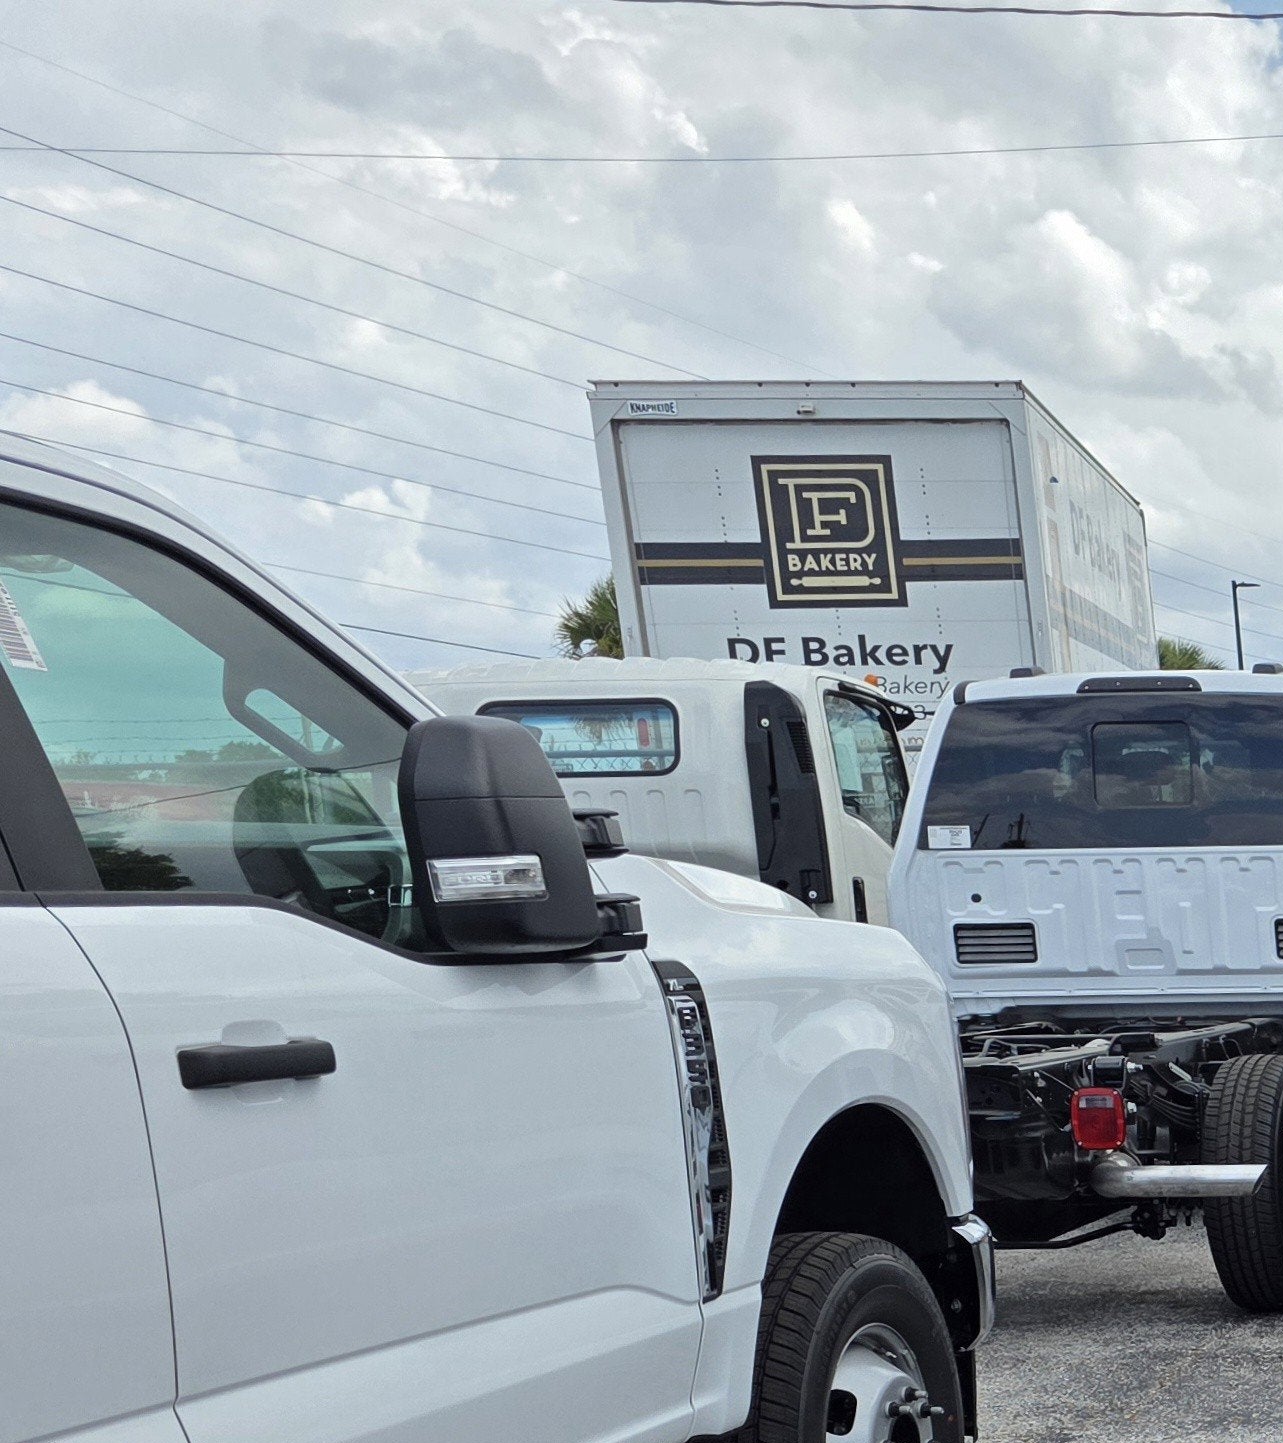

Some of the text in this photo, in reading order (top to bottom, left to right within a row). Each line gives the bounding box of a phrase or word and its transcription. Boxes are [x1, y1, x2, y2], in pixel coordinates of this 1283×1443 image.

[629, 402, 676, 414] KNAPHEIDE
[787, 553, 877, 572] BAKERY
[727, 634, 954, 674] DF Bakery
